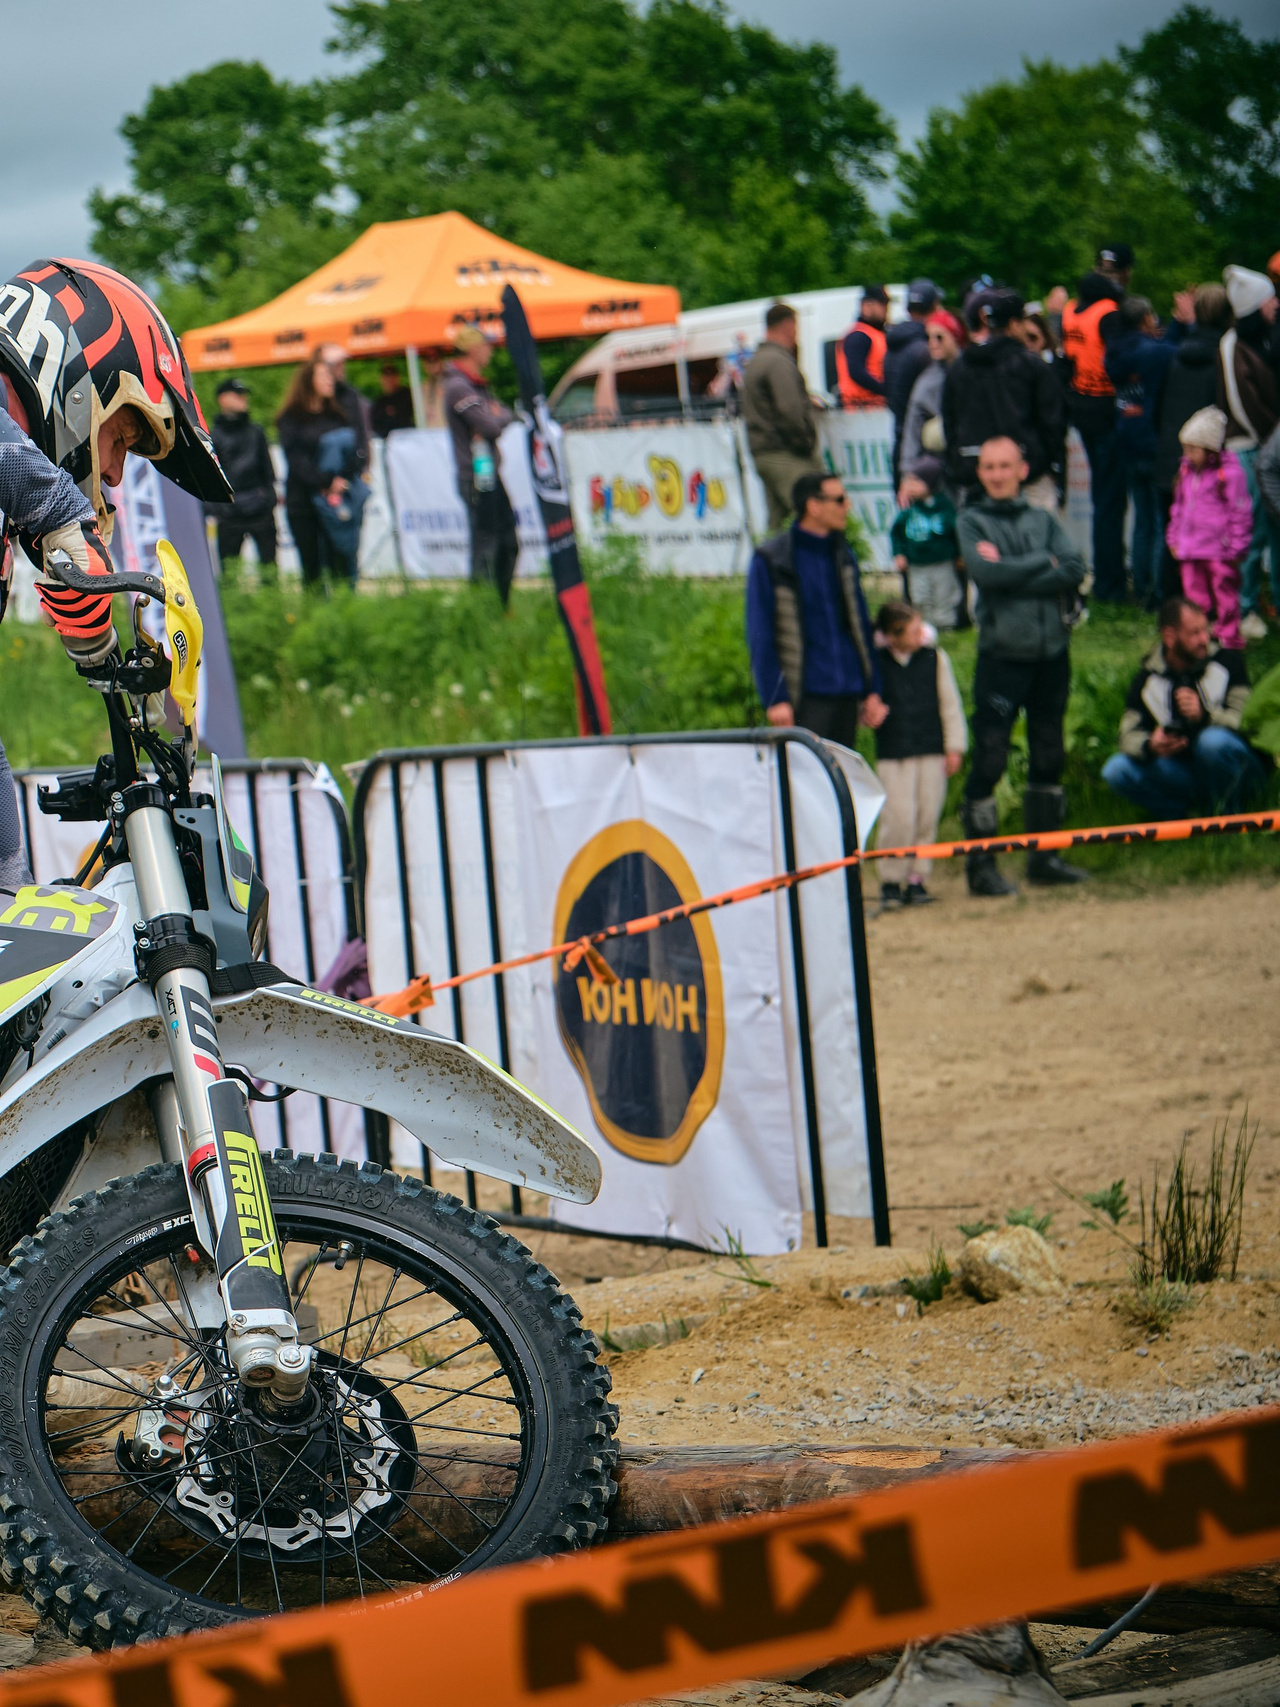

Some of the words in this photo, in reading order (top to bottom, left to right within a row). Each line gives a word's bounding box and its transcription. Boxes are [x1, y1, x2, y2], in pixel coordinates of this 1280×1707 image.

[165, 988, 177, 1016] XACT
[300, 989, 400, 1026] PIRELLI
[222, 1130, 282, 1276] PIRELLI
[162, 1213, 194, 1231] EXC
[54, 1227, 96, 1271] M+S
